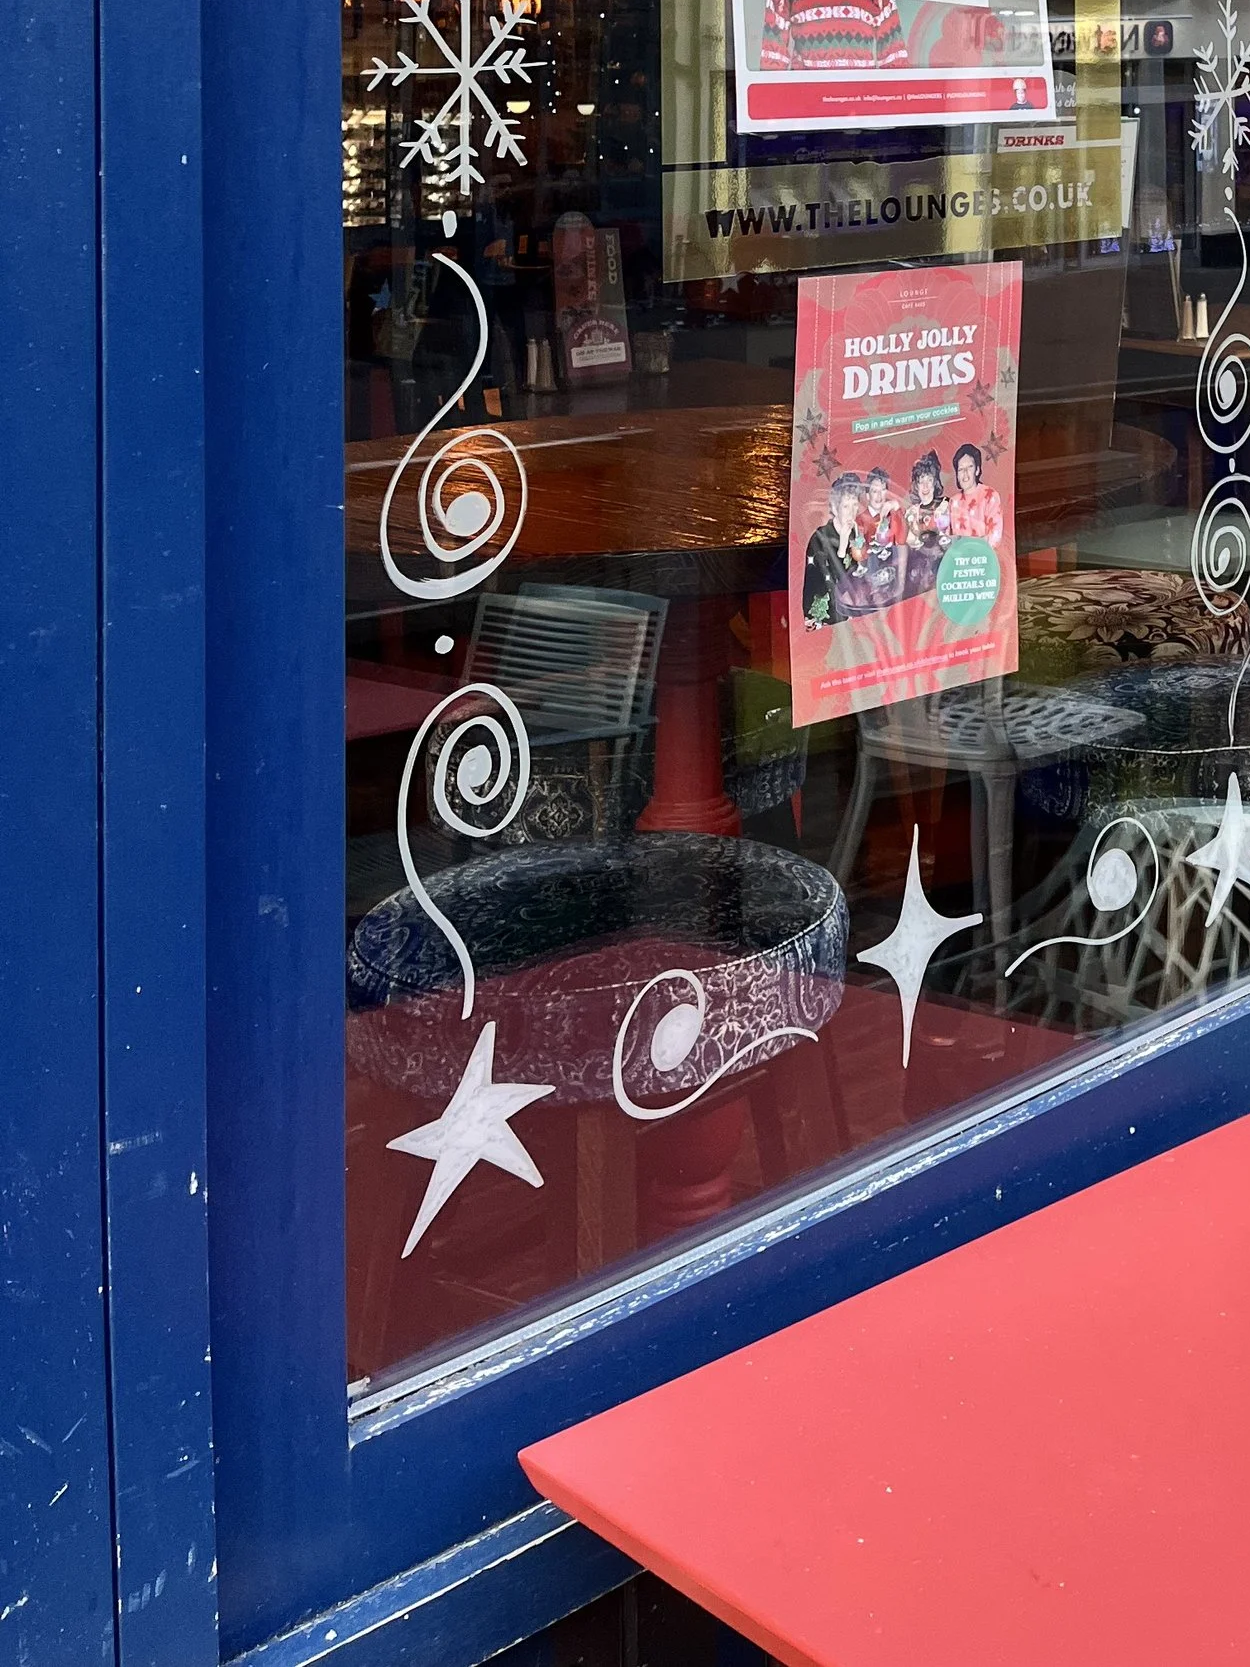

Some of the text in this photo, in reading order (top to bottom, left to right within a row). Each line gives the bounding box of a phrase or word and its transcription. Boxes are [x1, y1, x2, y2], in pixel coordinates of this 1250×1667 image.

[1003, 135, 1065, 148] DRINKS
[705, 182, 1094, 238] WWW.THELOUNGES.CO.UK
[605, 234, 618, 285] FOOD
[844, 324, 978, 358] HOLLY JOLLY
[842, 350, 976, 400] DRINKS
[855, 422, 870, 432] Pop
[870, 421, 878, 430] in
[880, 419, 893, 428] and
[894, 414, 915, 424] warm
[916, 412, 931, 422] your
[954, 557, 970, 566] TRY
[953, 568, 986, 578] FESTIVE
[941, 580, 984, 591] COCKTAILS
[942, 591, 995, 603] MULLED WINE
